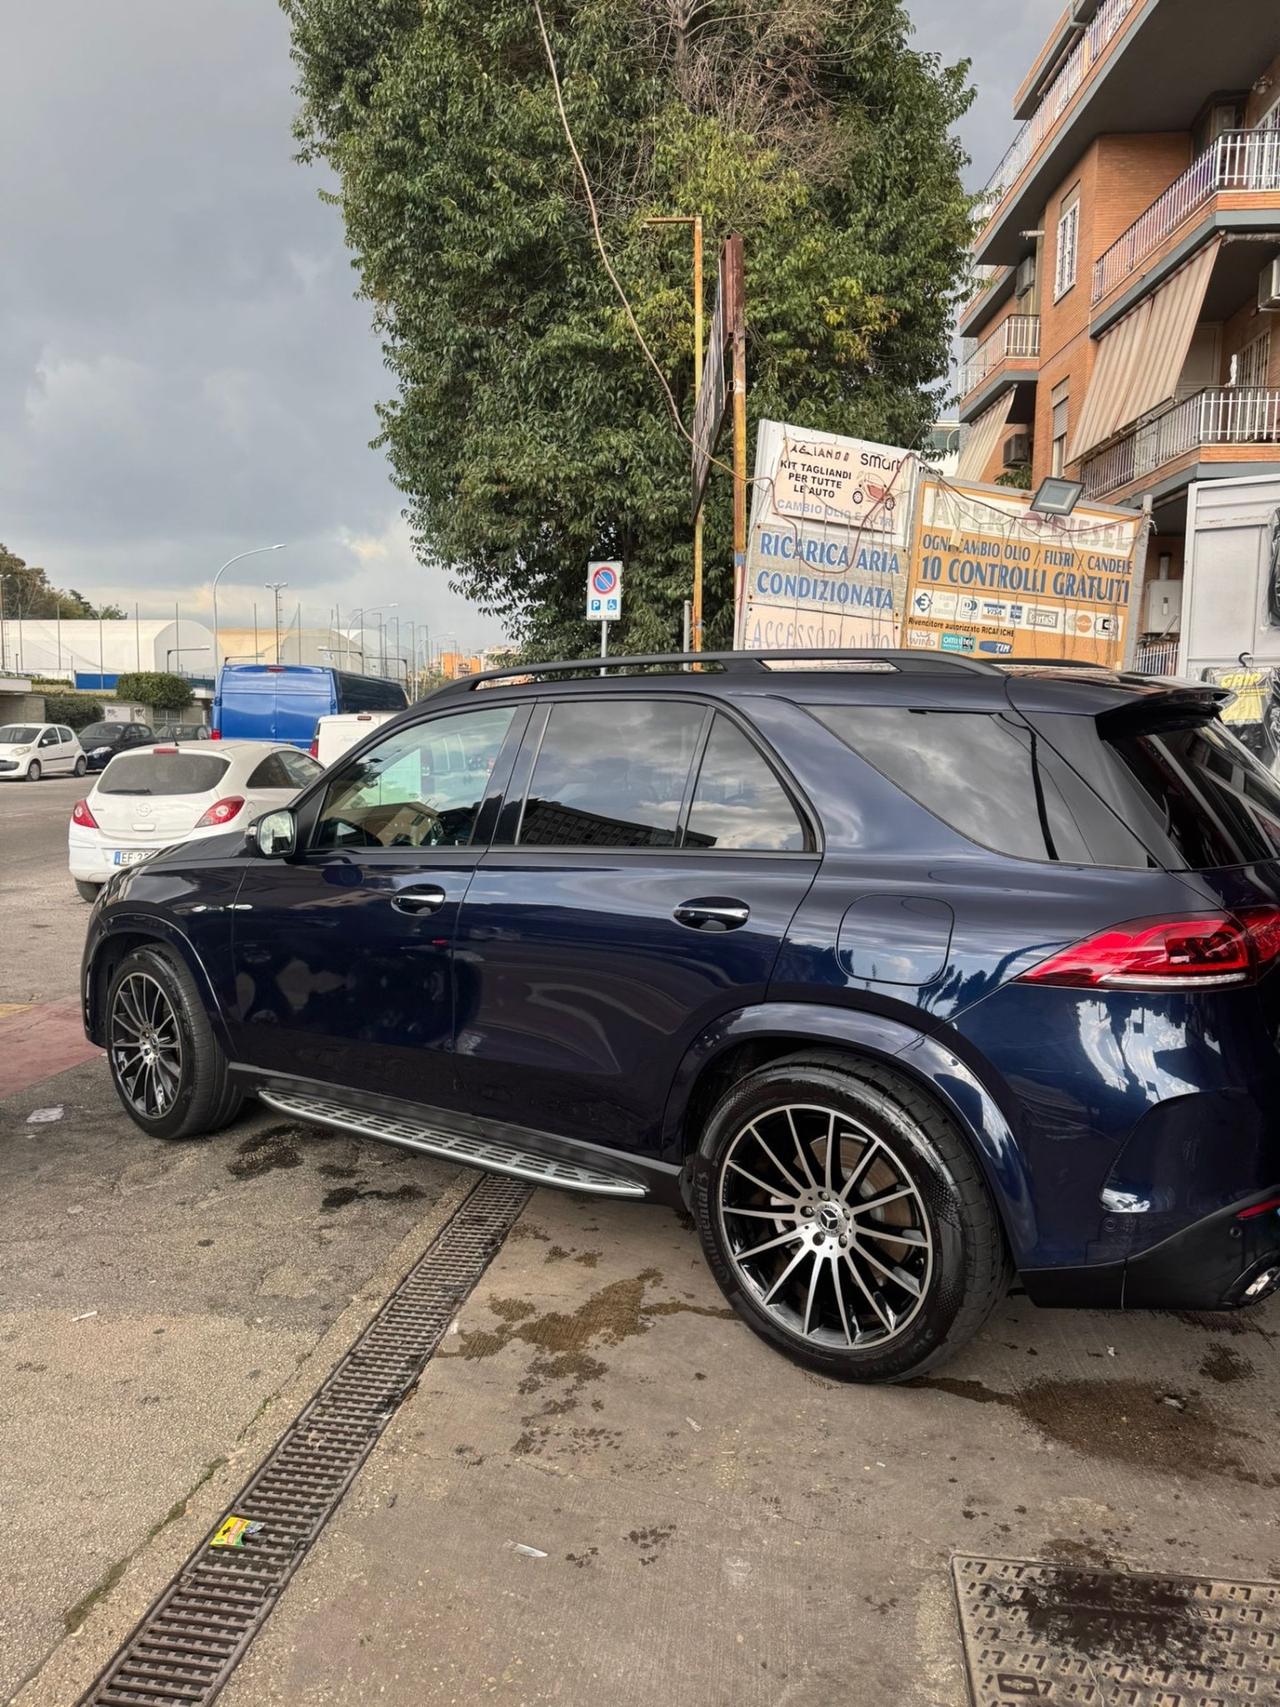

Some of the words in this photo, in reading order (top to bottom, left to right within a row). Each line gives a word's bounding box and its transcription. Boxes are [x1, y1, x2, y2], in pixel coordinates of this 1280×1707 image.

[780, 459, 797, 471] KIT
[801, 463, 852, 480] TAGLIANDI
[860, 452, 900, 473] smart
[788, 472, 808, 483] PER
[811, 475, 842, 489] TUTTE
[793, 484, 805, 493] LE
[809, 488, 835, 499] AUTO
[777, 499, 823, 514] CAMBIO
[760, 532, 849, 567] RICARICA
[856, 548, 899, 574] ARIA
[1005, 544, 1031, 562] OLIO
[1044, 549, 1074, 568] FILTRI
[1087, 555, 1133, 575] CANDELE
[922, 555, 942, 582] 10
[948, 557, 1047, 594] CONTROLLI
[1053, 570, 1130, 604] GRATUITI
[757, 570, 894, 609] CONDIZIONATA
[987, 607, 1002, 616] VISA
[908, 616, 944, 629] Rivenditore
[944, 621, 981, 633] autorizzato
[995, 643, 1011, 653] TIM
[121, 852, 133, 863] EF
